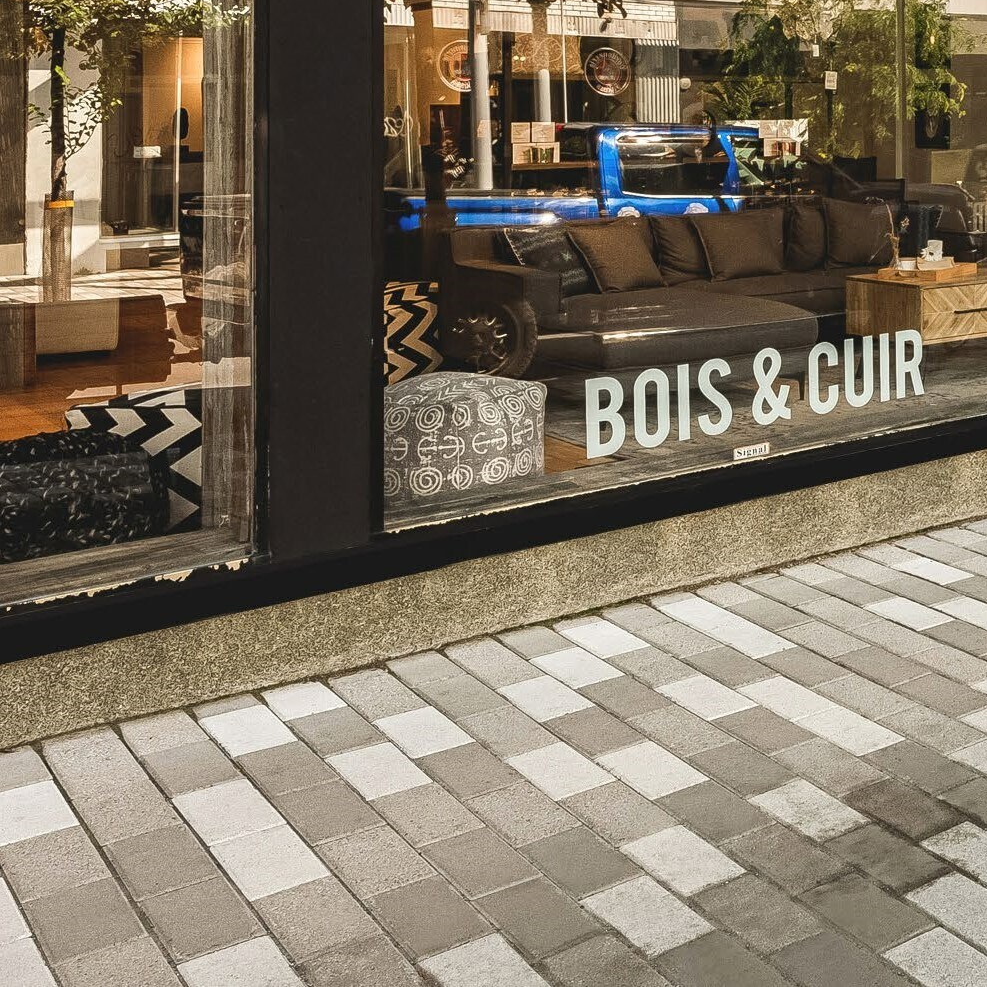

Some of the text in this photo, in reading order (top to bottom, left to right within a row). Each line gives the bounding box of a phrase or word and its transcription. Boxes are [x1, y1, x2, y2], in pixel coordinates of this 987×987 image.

[586, 329, 926, 460] BOIS & CUIR
[736, 444, 766, 457] Signal
